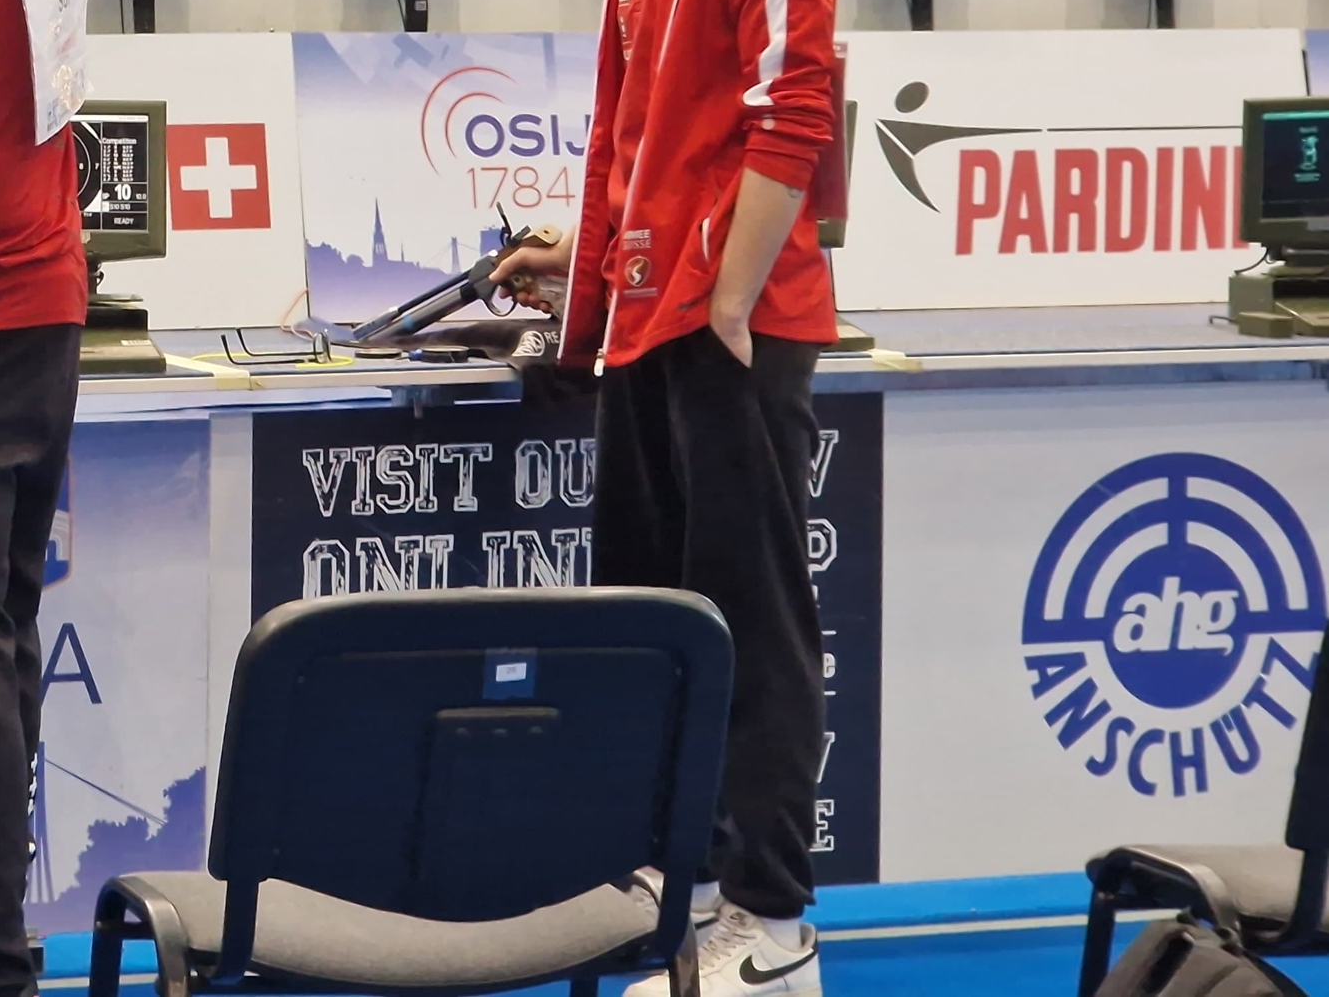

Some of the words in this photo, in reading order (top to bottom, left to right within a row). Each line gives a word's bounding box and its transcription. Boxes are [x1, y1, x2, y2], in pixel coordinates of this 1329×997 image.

[114, 183, 132, 201] 10
[114, 216, 134, 225] READY
[467, 166, 576, 209] 1784
[302, 442, 493, 518] VISIT
[303, 526, 593, 601] ONLIN
[1113, 576, 1239, 657] ahg
[1023, 635, 1321, 798] ANSCHÜTZ
